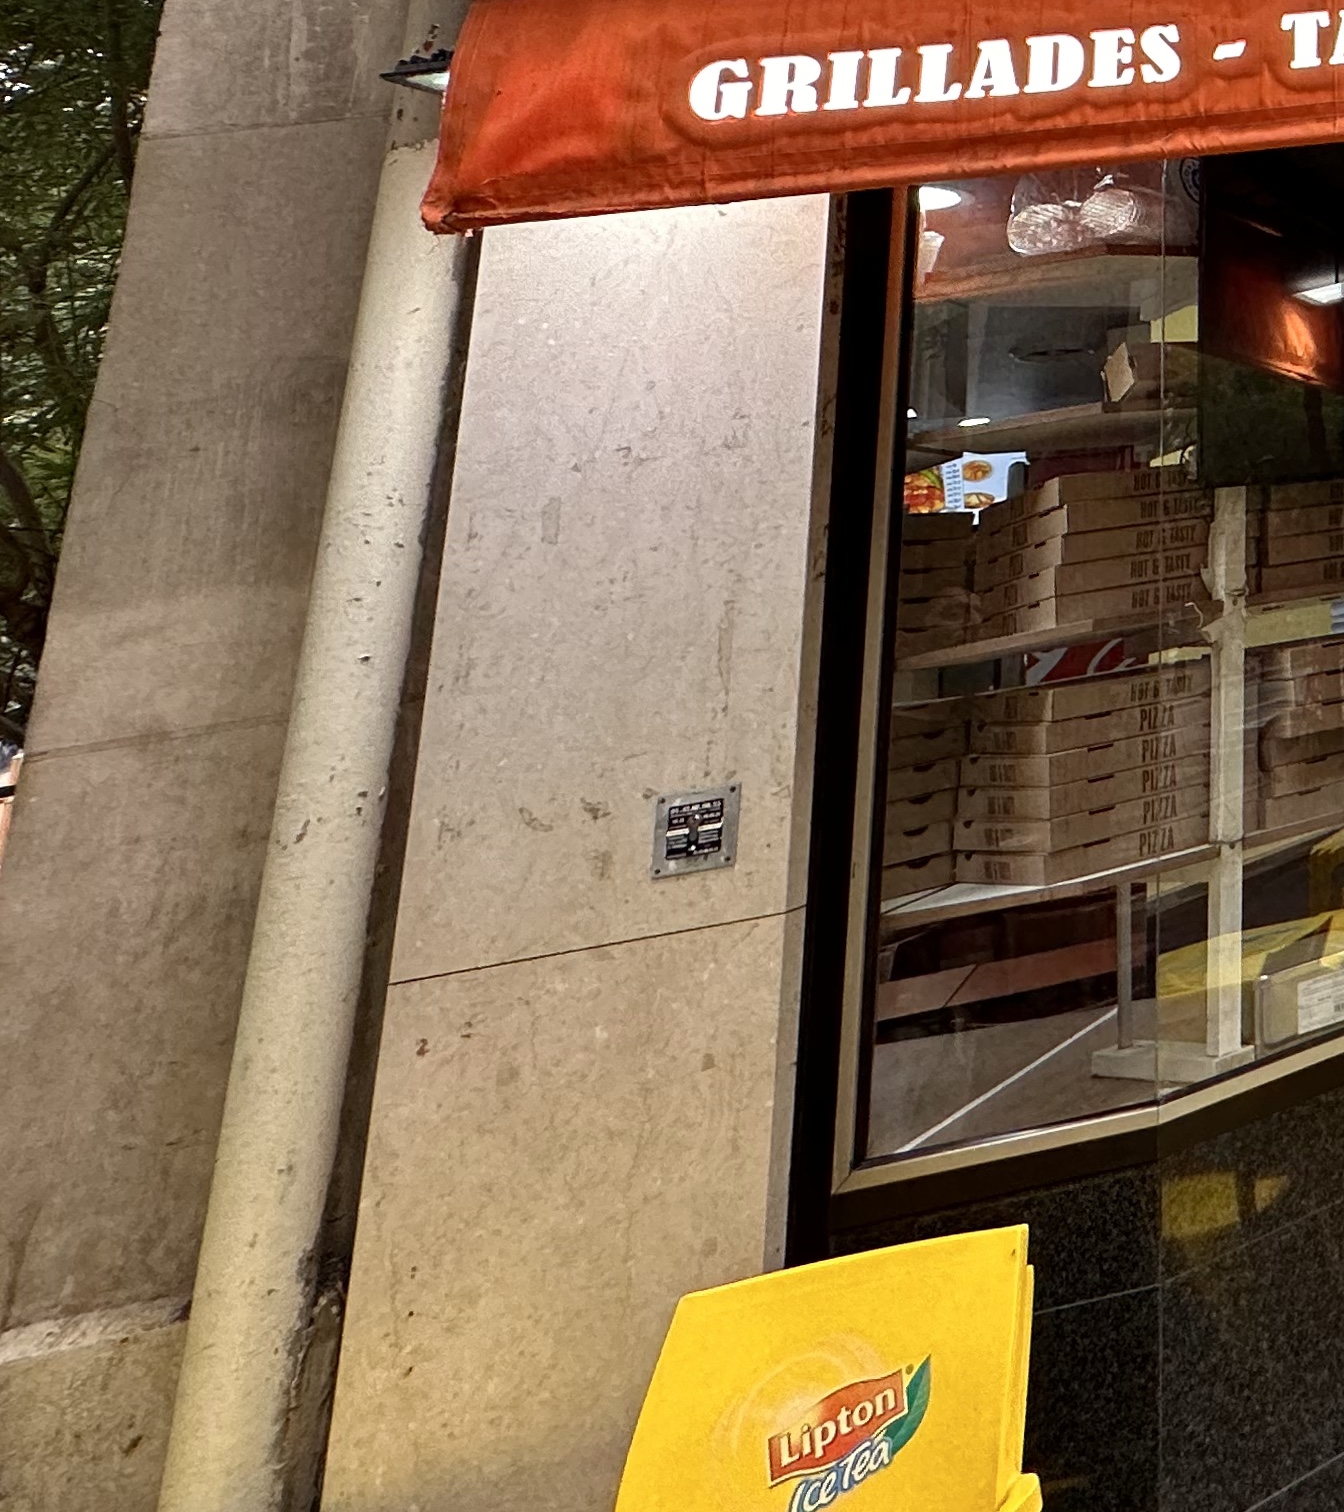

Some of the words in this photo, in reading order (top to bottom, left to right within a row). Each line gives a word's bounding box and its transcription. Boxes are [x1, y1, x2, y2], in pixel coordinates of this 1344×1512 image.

[688, 24, 1181, 124] GRILLADES
[1140, 705, 1175, 732] PIZZA
[1140, 827, 1175, 857] PIZZA
[778, 1386, 896, 1468] Lipton
[837, 1434, 892, 1488] Tea
